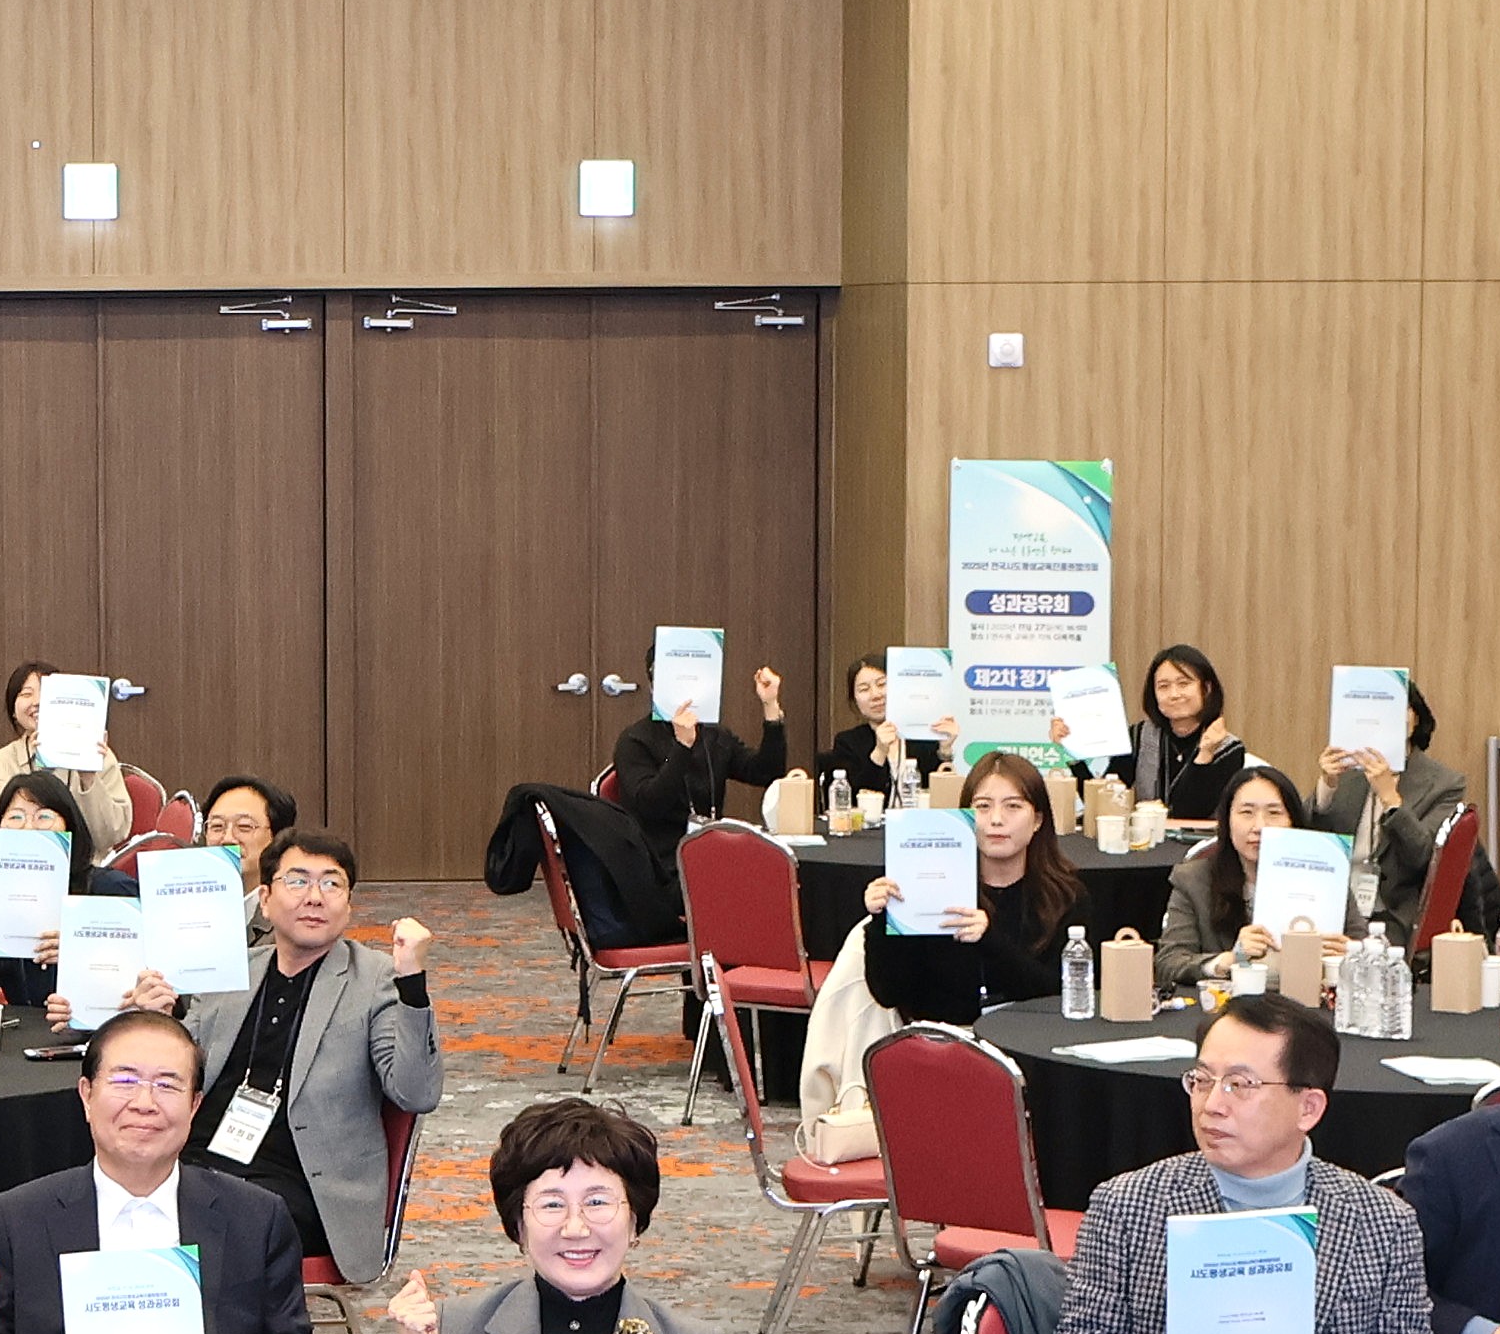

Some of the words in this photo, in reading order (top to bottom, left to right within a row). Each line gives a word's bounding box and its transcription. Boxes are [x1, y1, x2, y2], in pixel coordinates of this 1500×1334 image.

[989, 593, 1070, 614] 성과공유회
[973, 668, 1018, 688] 제2차
[84, 1301, 136, 1312] 시도평생교육
[138, 1298, 180, 1309] 성과공유회
